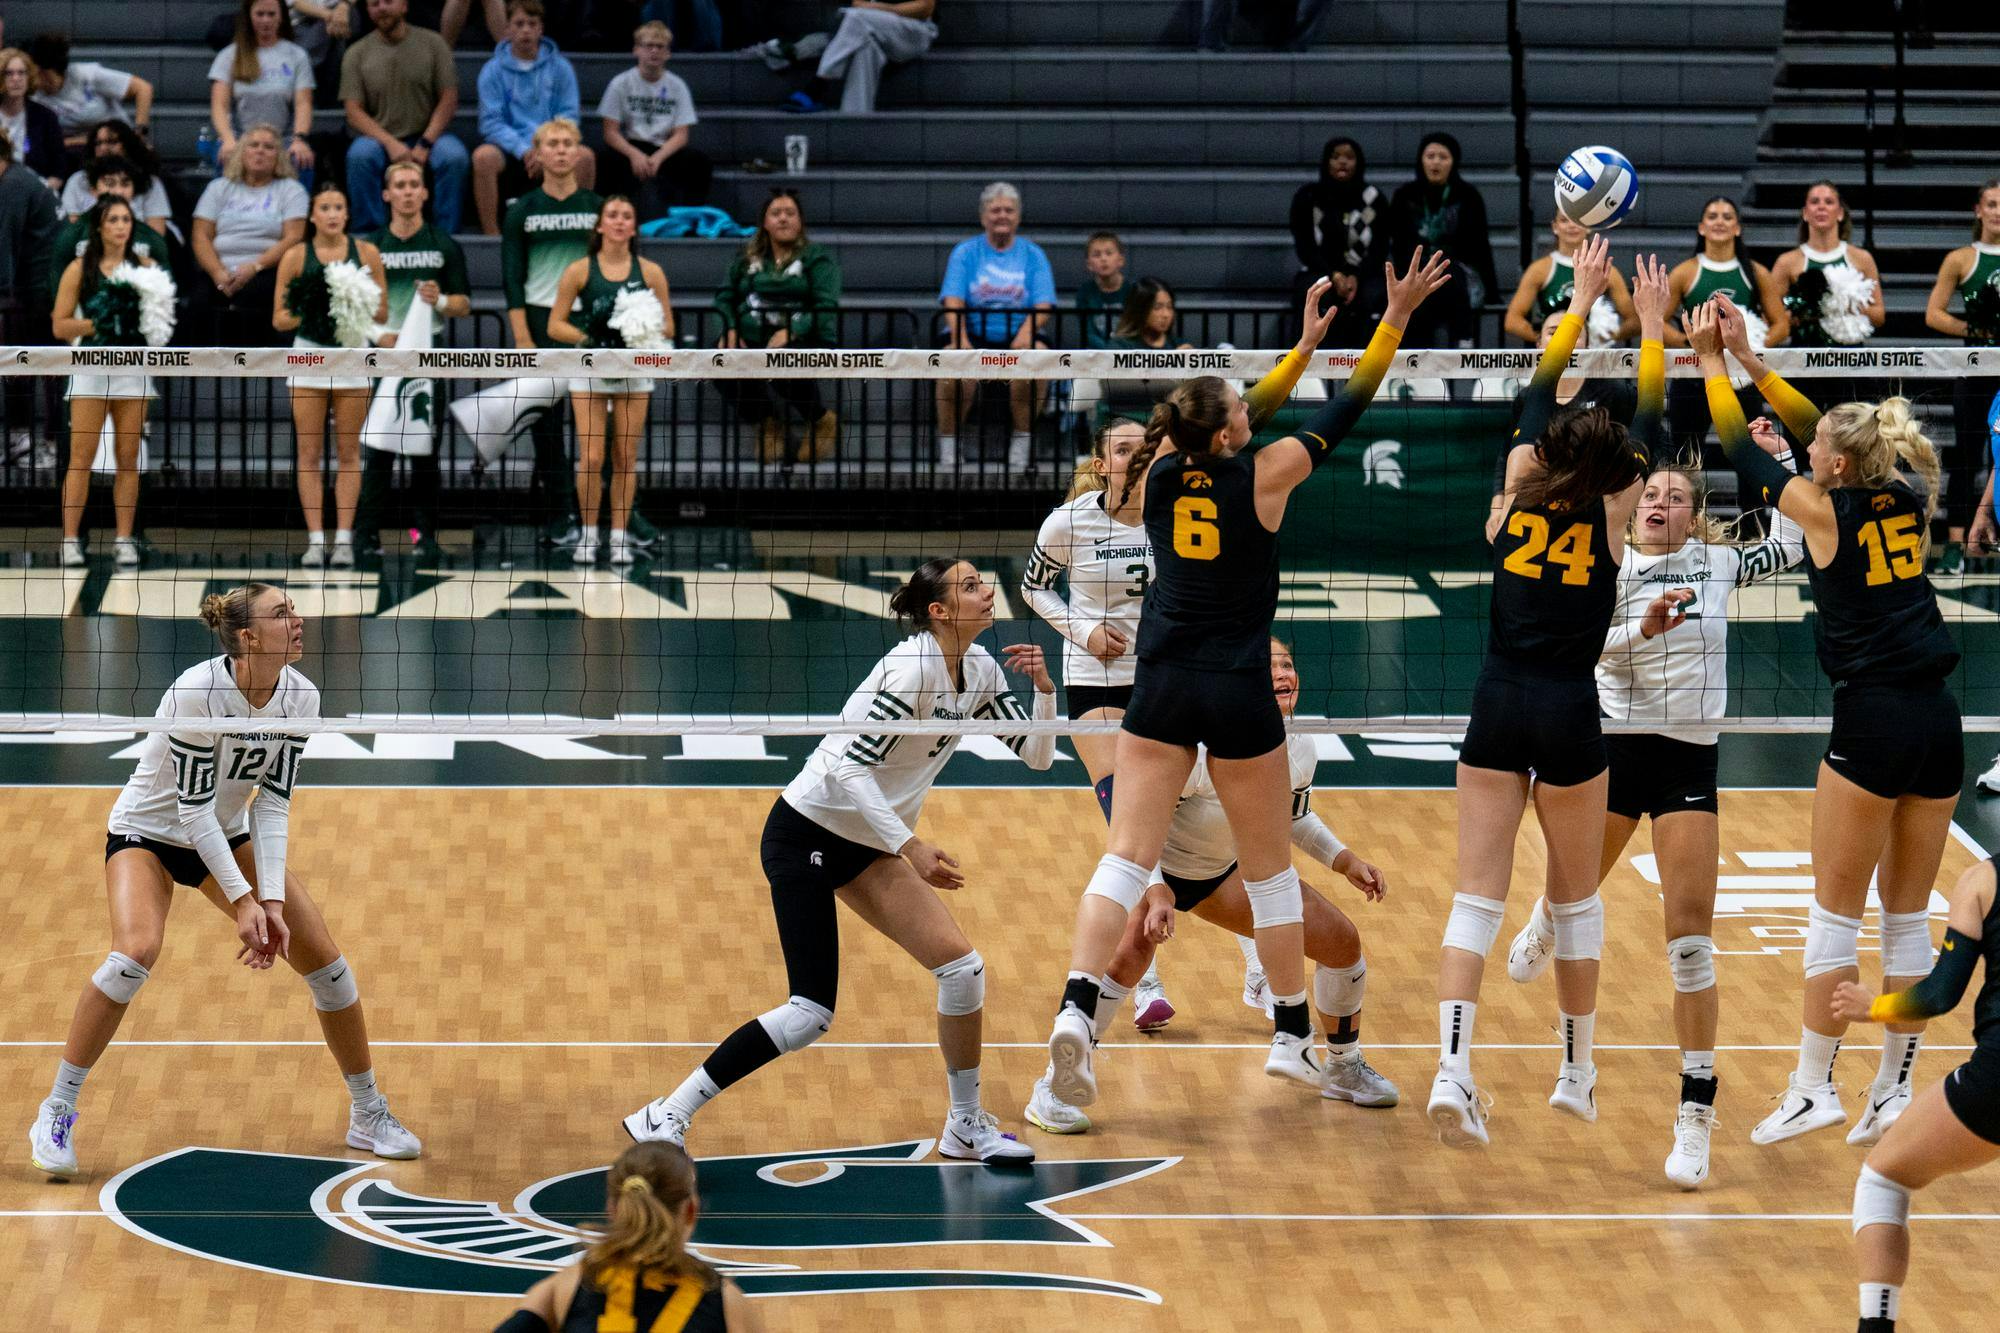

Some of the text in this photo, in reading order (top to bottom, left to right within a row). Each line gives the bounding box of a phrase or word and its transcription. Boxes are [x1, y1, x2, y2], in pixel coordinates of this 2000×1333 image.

[524, 212, 599, 232] SPARTANS
[380, 250, 444, 270] PARTANS
[71, 351, 190, 366] MICHIGAN STATE
[287, 354, 325, 367] meijer
[418, 352, 537, 368] MICHIGAN STATE
[634, 355, 672, 368] meijer
[765, 353, 884, 368] MICHIGAN STATE
[981, 355, 1019, 367] meijer
[1113, 353, 1231, 368] MICHIGAN STATE
[1328, 355, 1360, 368] meije
[1460, 353, 1532, 368] MICHIGAN
[1674, 354, 1701, 367] meij
[1806, 352, 1923, 367] MICHIGAN STATE
[1173, 496, 1221, 560] 6
[1095, 546, 1147, 560] MICHIGAN
[1504, 511, 1595, 586] 24
[1857, 512, 1924, 586] 15
[1126, 563, 1149, 597] 3
[226, 747, 268, 780] 12
[596, 1263, 706, 1333] 17
